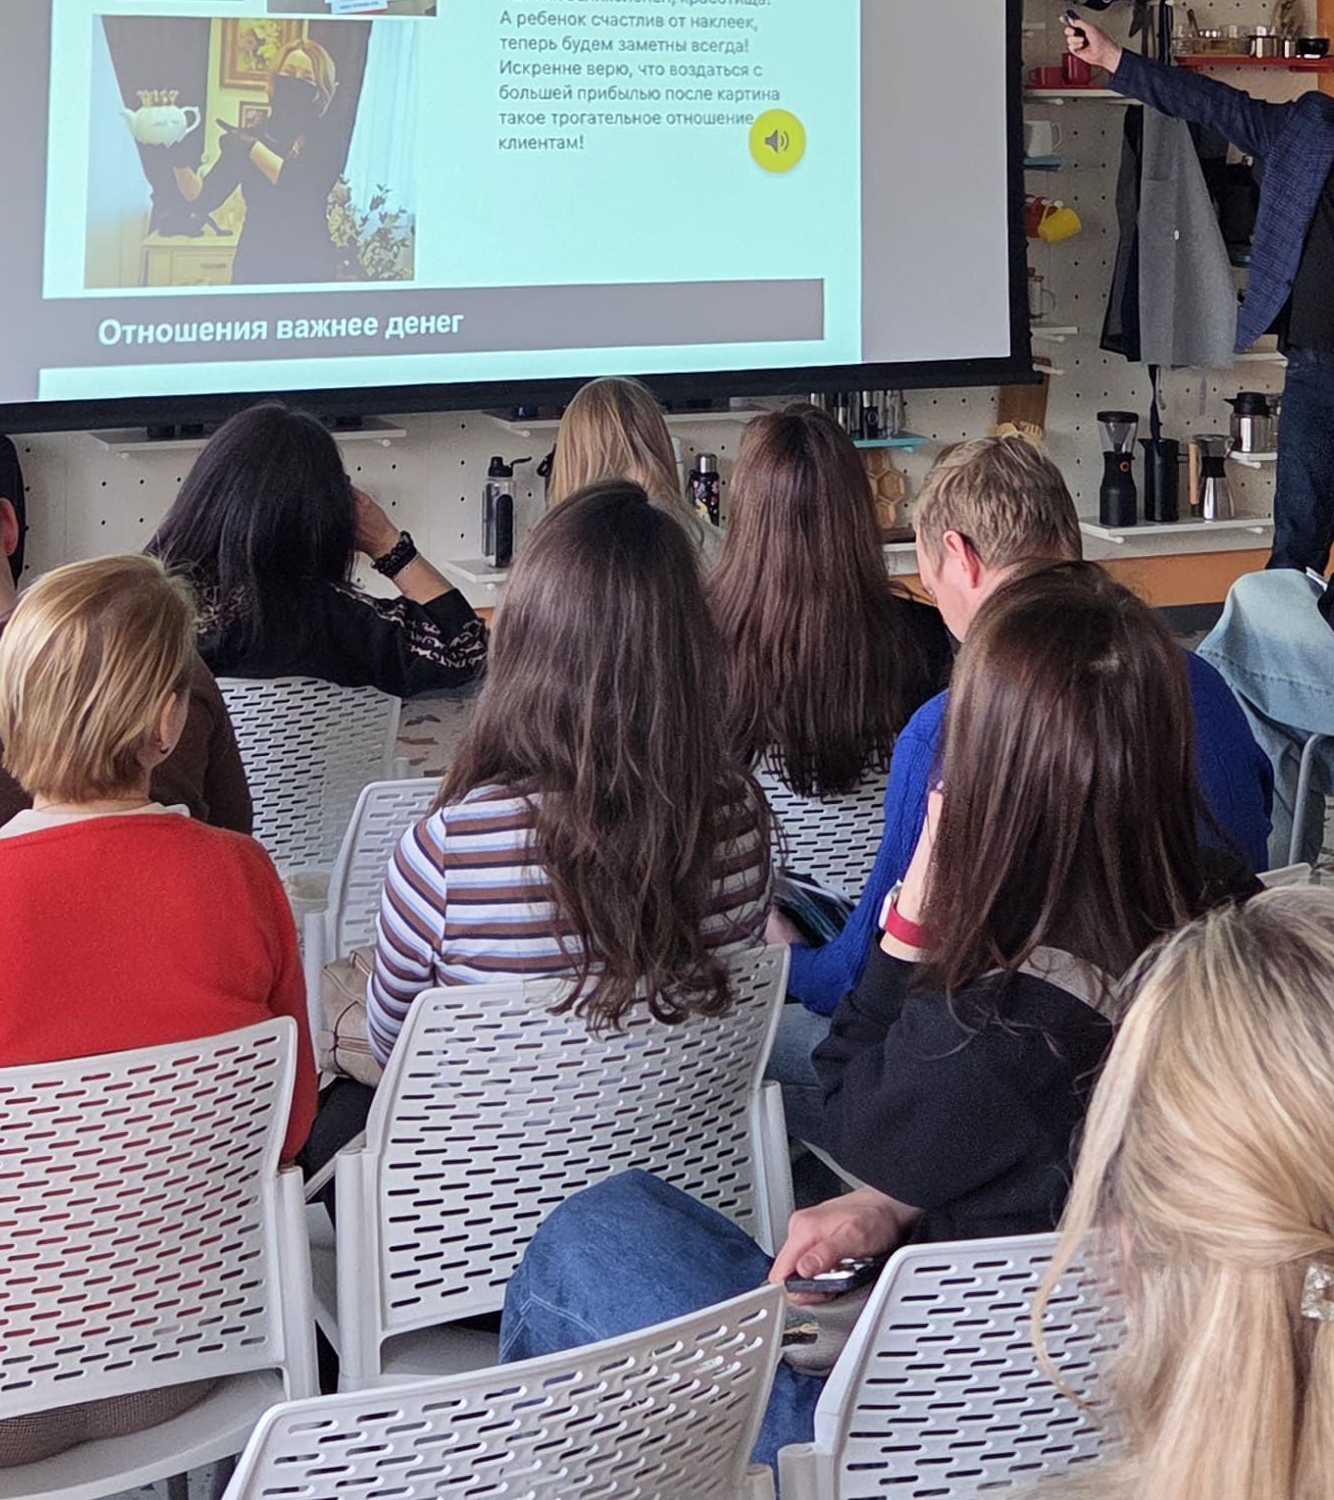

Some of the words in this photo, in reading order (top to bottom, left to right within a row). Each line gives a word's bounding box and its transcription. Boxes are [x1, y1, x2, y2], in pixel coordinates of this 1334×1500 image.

[499, 10, 512, 25] А
[517, 10, 586, 28] ребенок
[591, 14, 665, 28] счастлив
[668, 16, 686, 28] от
[690, 16, 758, 32] наклеек,
[499, 37, 558, 53] теперь
[562, 35, 613, 54] будем
[618, 39, 687, 52] заметны
[691, 38, 749, 54] всегда!
[499, 60, 582, 78] Искренне
[586, 63, 633, 79] верю,
[638, 64, 665, 76] что
[669, 64, 749, 78] воздаться
[753, 65, 763, 77] с
[498, 84, 573, 100] большей
[577, 85, 661, 104] прибылью
[665, 88, 713, 101] после
[717, 88, 780, 103] картина
[498, 112, 546, 125] такое
[550, 112, 662, 127] трогательное
[666, 112, 755, 125] отношение
[498, 134, 585, 150] клиентам!
[98, 318, 268, 346] Отношения
[276, 315, 379, 340] важнее
[384, 313, 464, 340] денег
